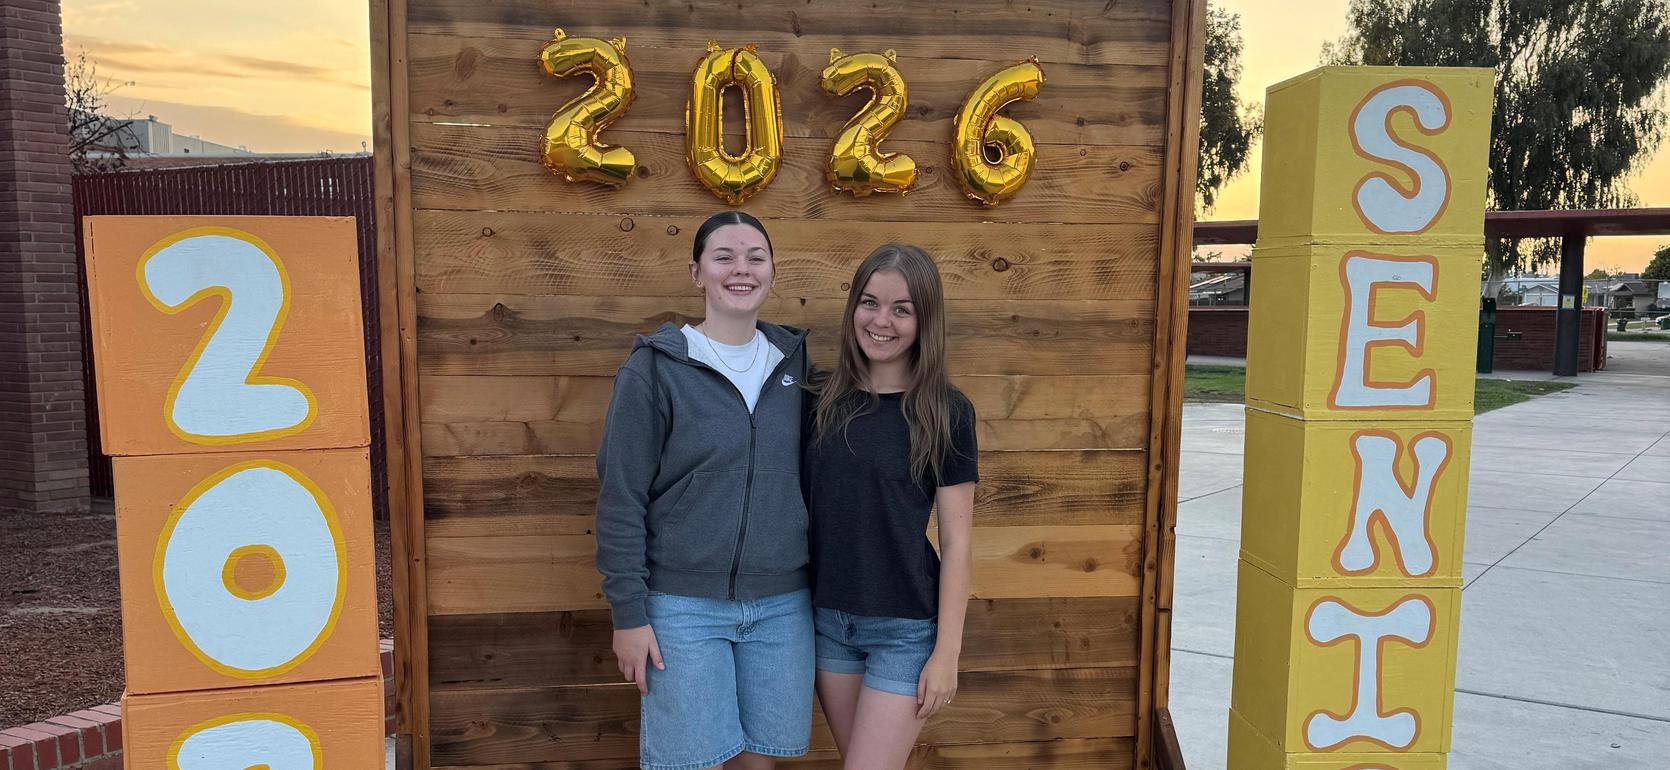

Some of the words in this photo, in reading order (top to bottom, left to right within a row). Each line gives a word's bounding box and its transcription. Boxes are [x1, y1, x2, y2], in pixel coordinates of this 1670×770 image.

[537, 28, 1047, 206] 2026
[136, 226, 347, 770] 20
[1302, 78, 1453, 770] SENI
